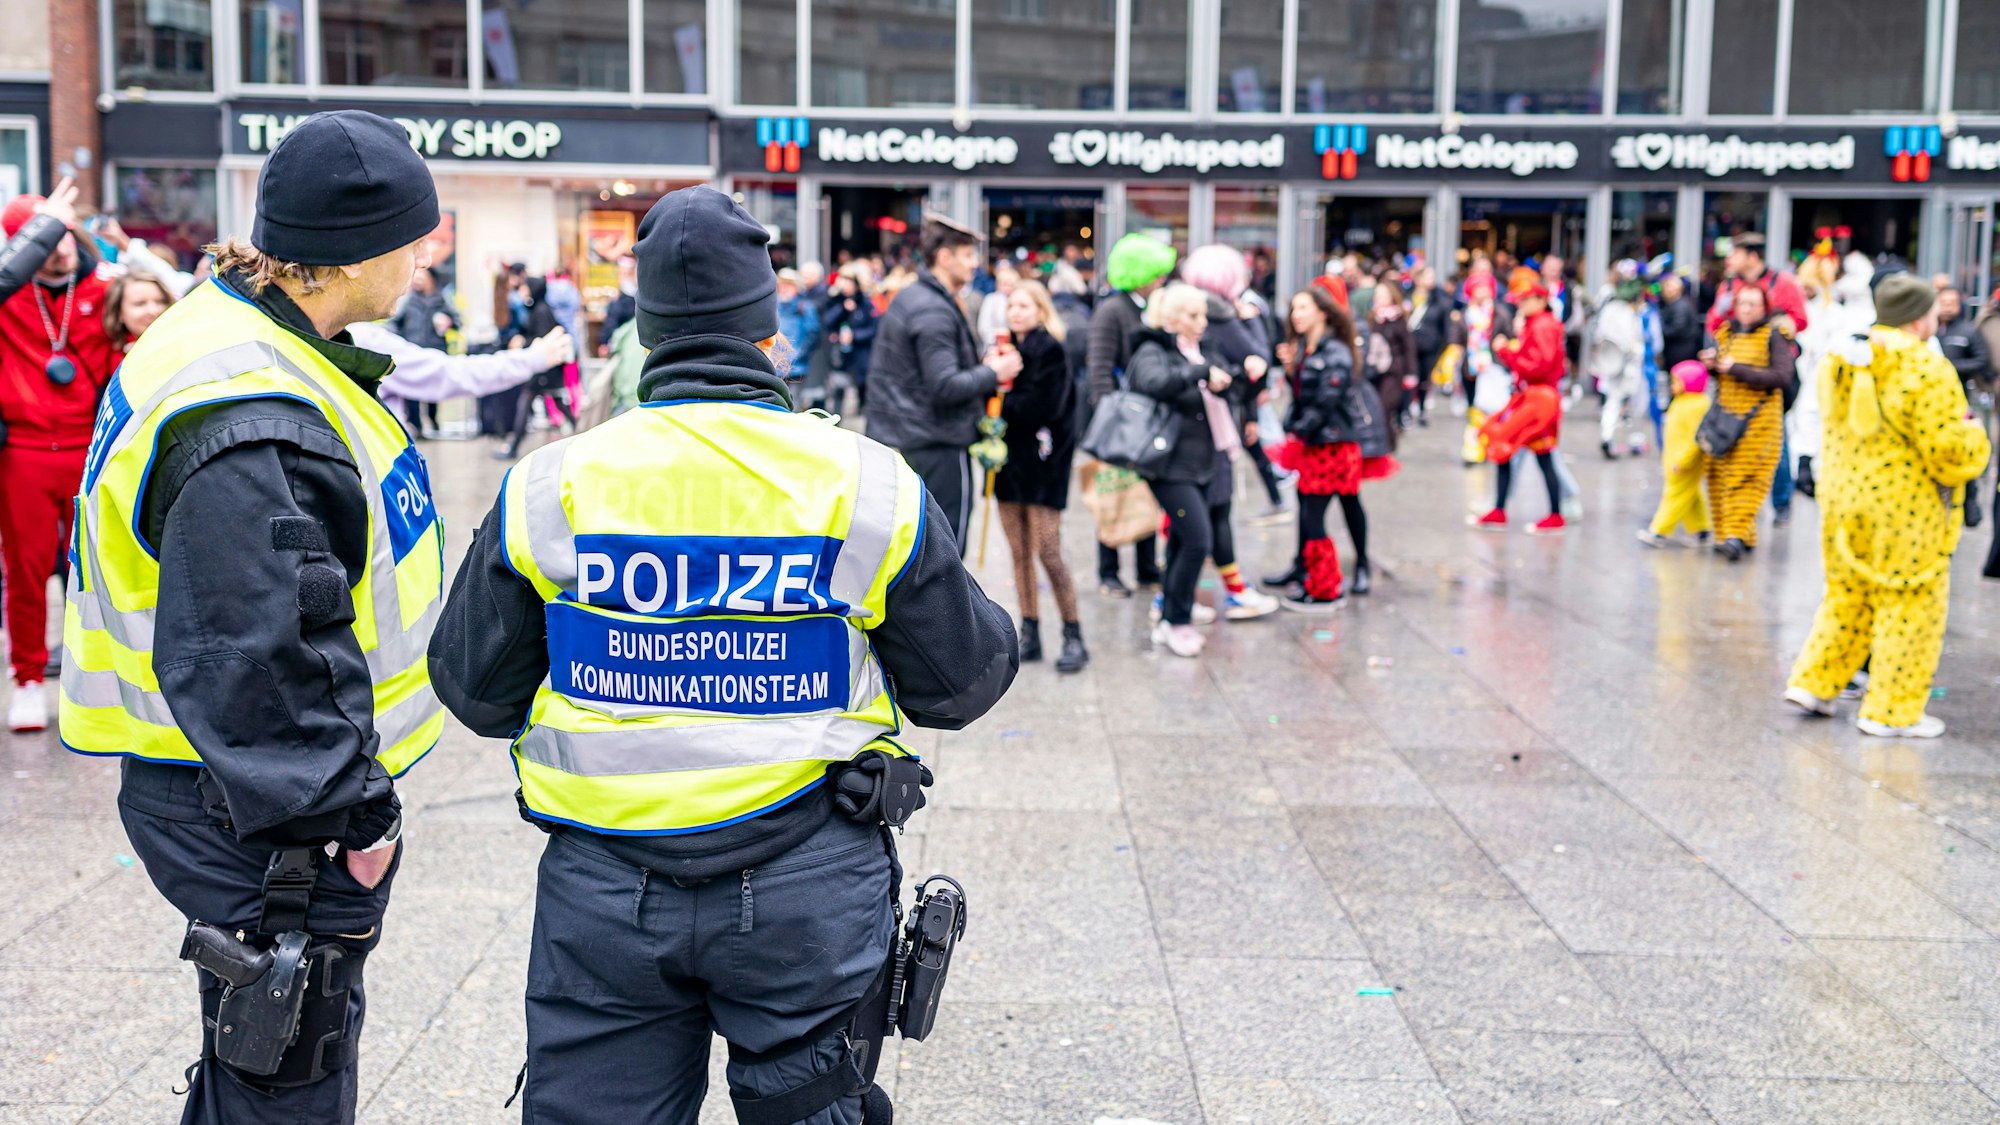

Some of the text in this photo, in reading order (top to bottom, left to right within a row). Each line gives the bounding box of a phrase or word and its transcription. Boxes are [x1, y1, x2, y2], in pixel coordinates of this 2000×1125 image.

[239, 113, 561, 159] TH DY SHOP
[818, 127, 1018, 170] NetCologne
[1107, 131, 1285, 173] Highspeed
[1376, 133, 1578, 176] NetCologne
[1672, 134, 1855, 176] Highspeed
[1947, 135, 2000, 170] Ne
[397, 471, 429, 530] POL
[577, 552, 828, 613] POLIZEI
[608, 629, 787, 662] BUNDESPOLIZEI
[571, 661, 829, 704] KOMMUNIKATIONSTEAM
